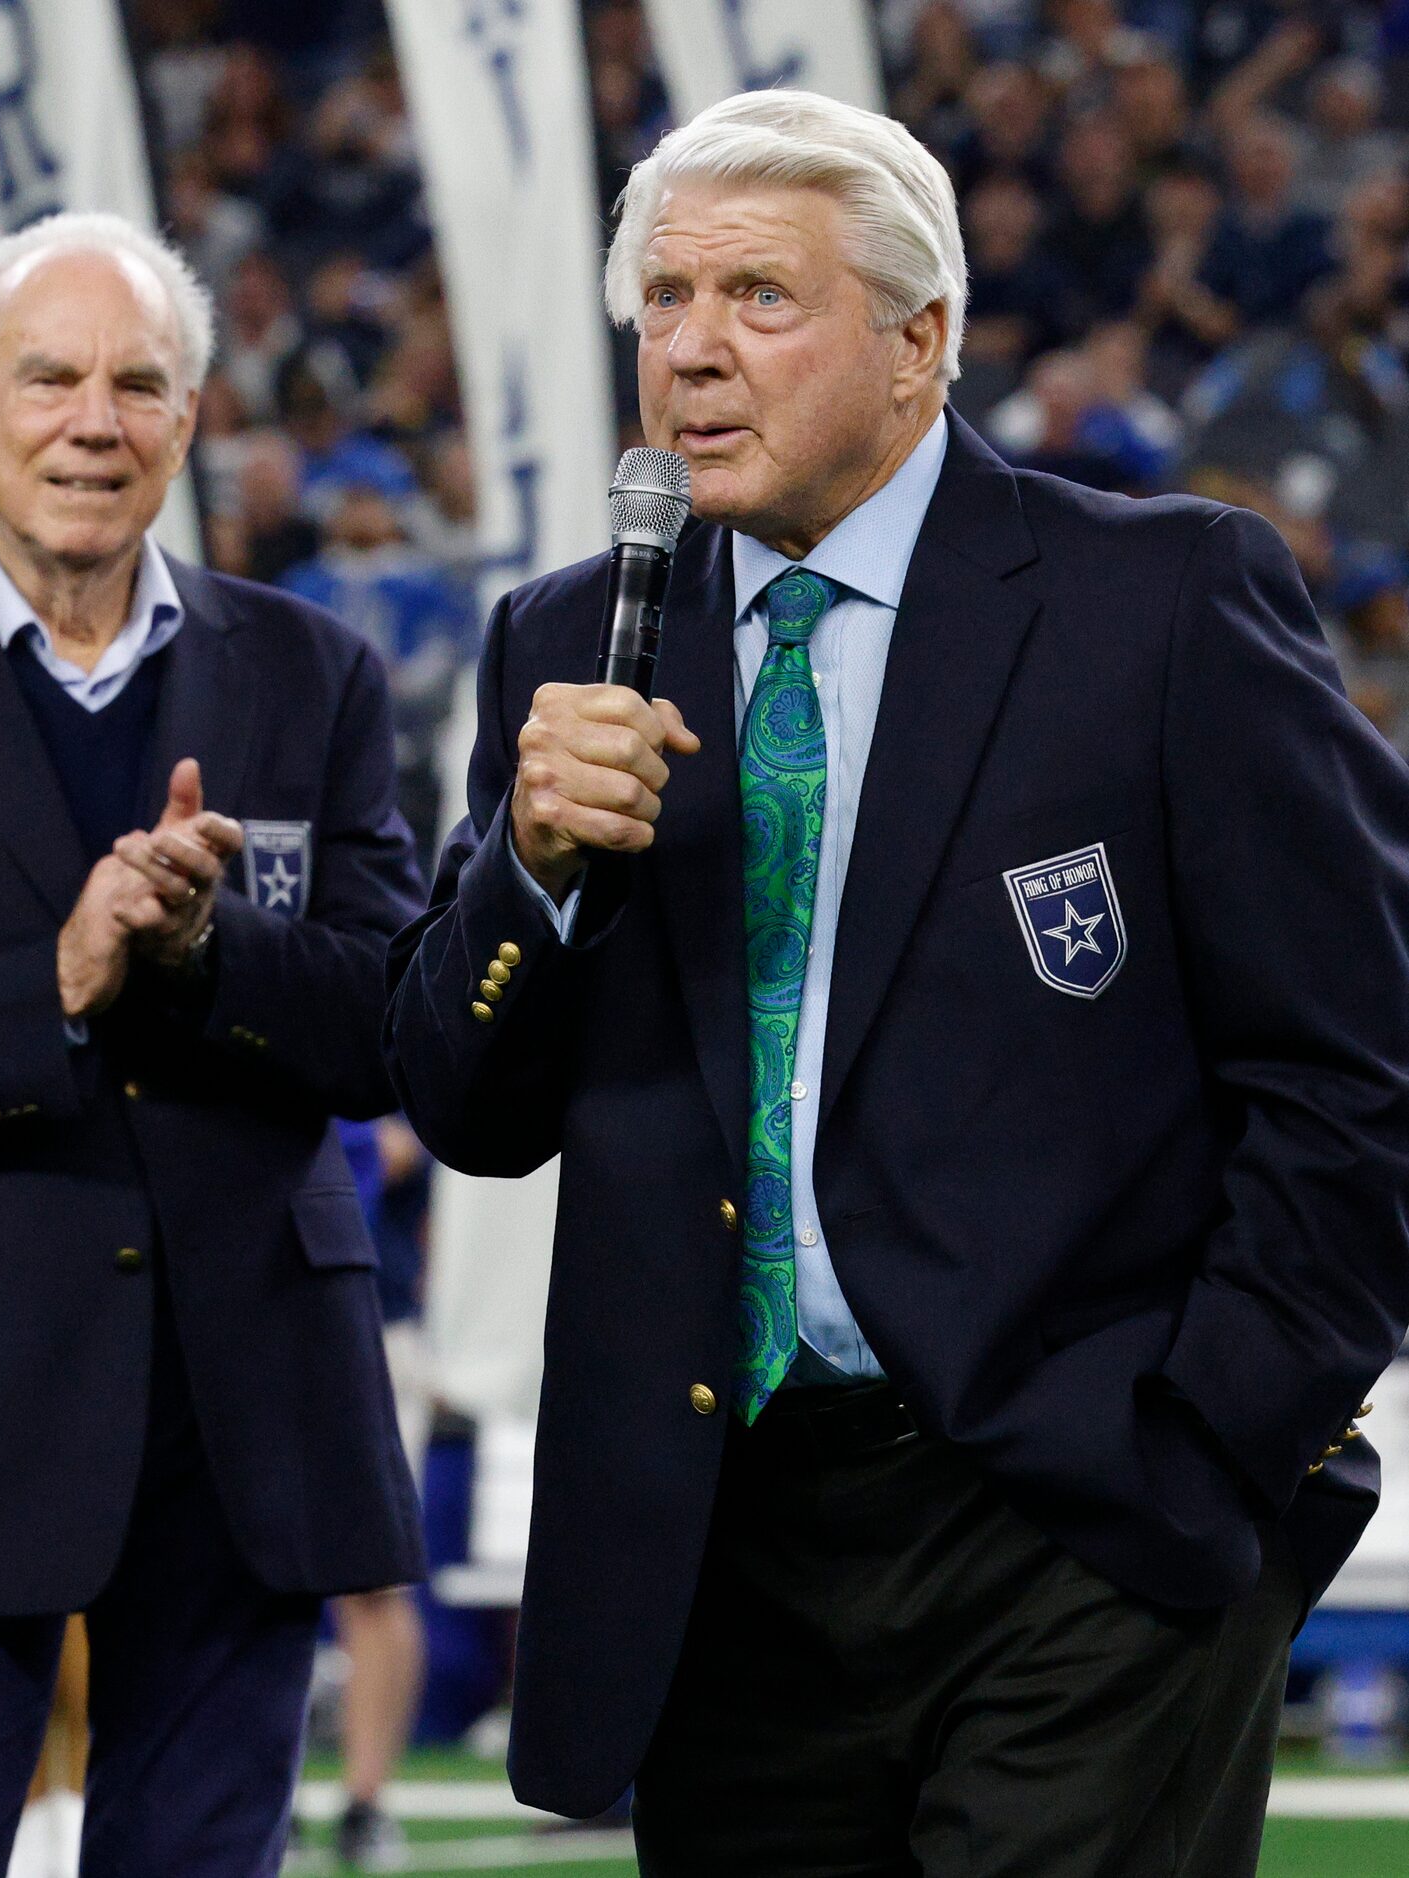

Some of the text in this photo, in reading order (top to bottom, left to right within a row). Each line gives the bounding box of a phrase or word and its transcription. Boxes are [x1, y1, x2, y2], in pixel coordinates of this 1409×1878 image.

[1021, 862, 1098, 898] RING OF HONOR
